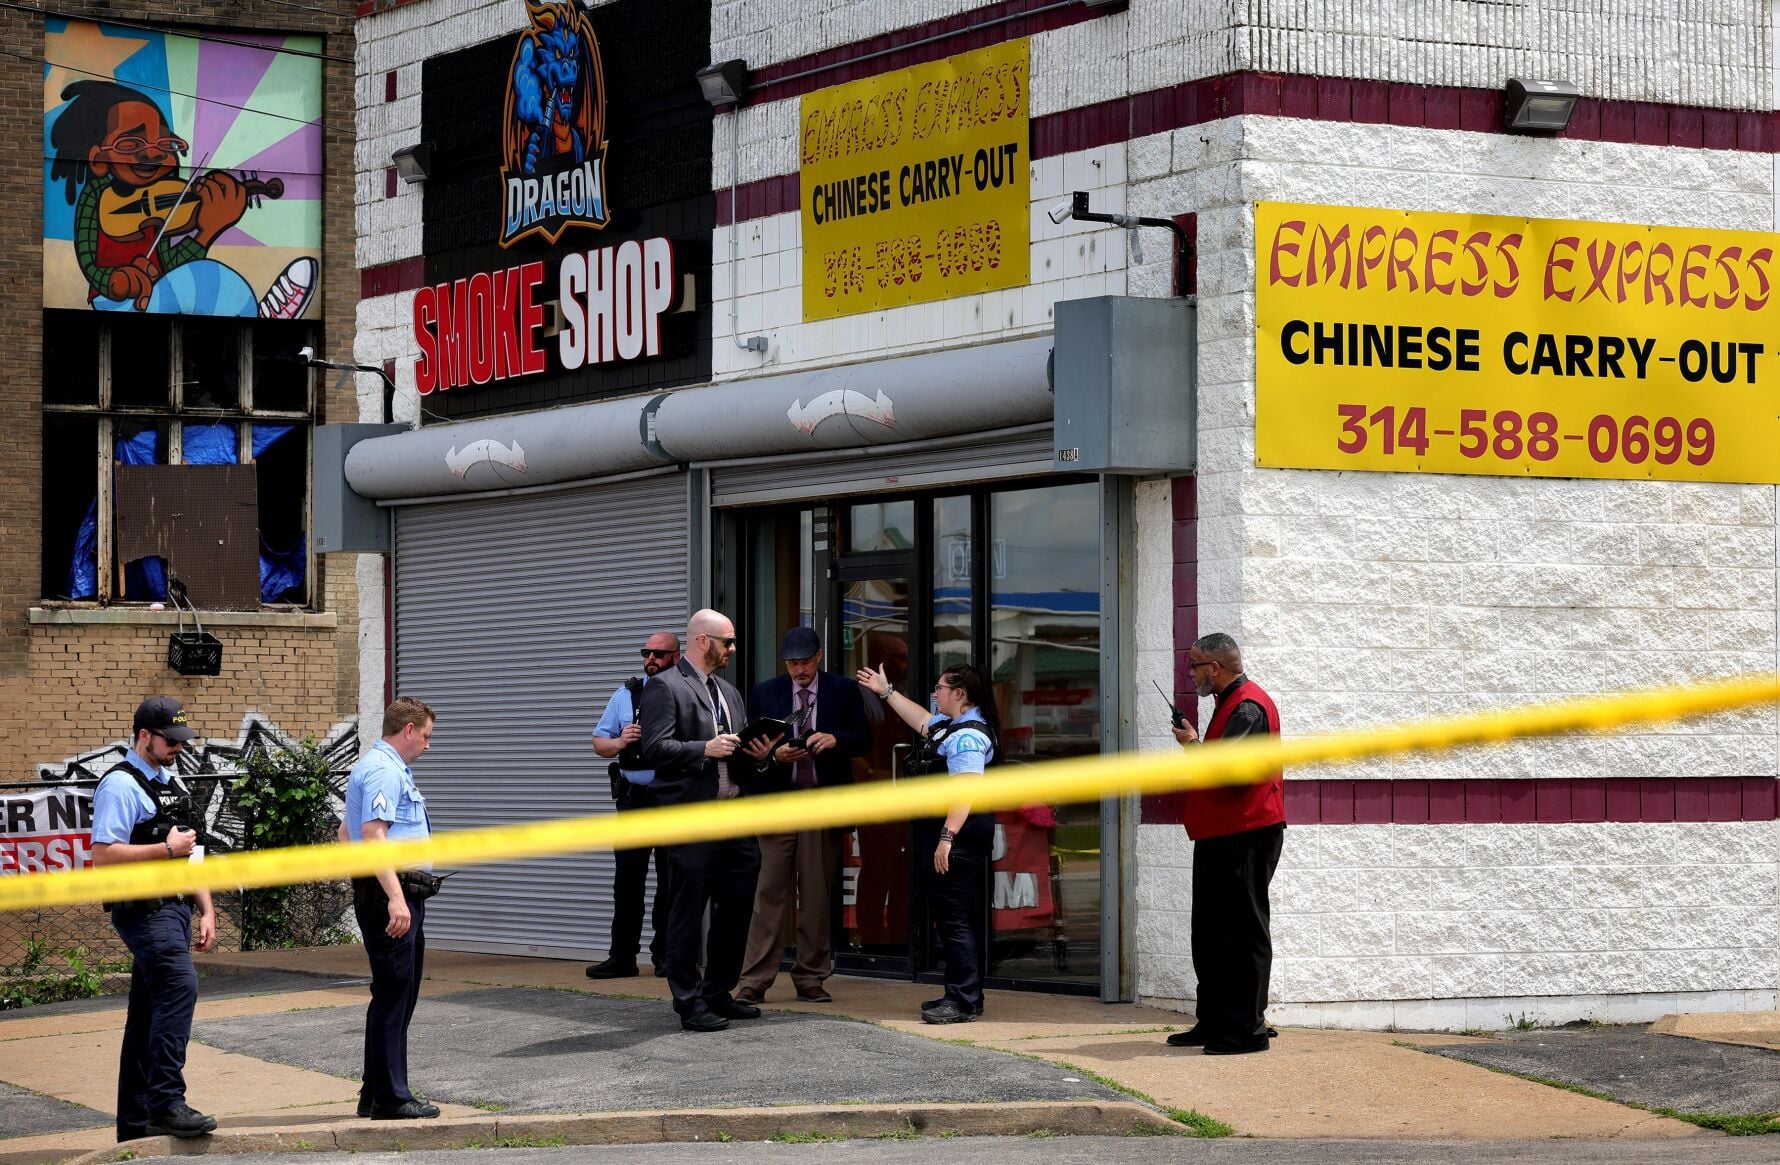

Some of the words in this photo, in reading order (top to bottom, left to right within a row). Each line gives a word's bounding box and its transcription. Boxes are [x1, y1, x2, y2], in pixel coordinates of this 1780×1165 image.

[802, 87, 907, 165] EMPRESS
[912, 58, 1025, 141] EXPRESS
[505, 159, 604, 238] DRAGON
[812, 169, 891, 225] CHINESE
[899, 142, 1018, 207] CARRY-OUT
[824, 219, 1001, 298] 314-588-0699
[1269, 220, 1523, 299] EMPRESS
[1543, 236, 1774, 312] EXPRESS
[413, 260, 546, 397] SMOKE
[559, 236, 675, 370] SHOP
[1280, 319, 1481, 373] CHINESE
[1503, 331, 1765, 385] CARRY-OUT
[1337, 403, 1716, 467] 314-588-0699
